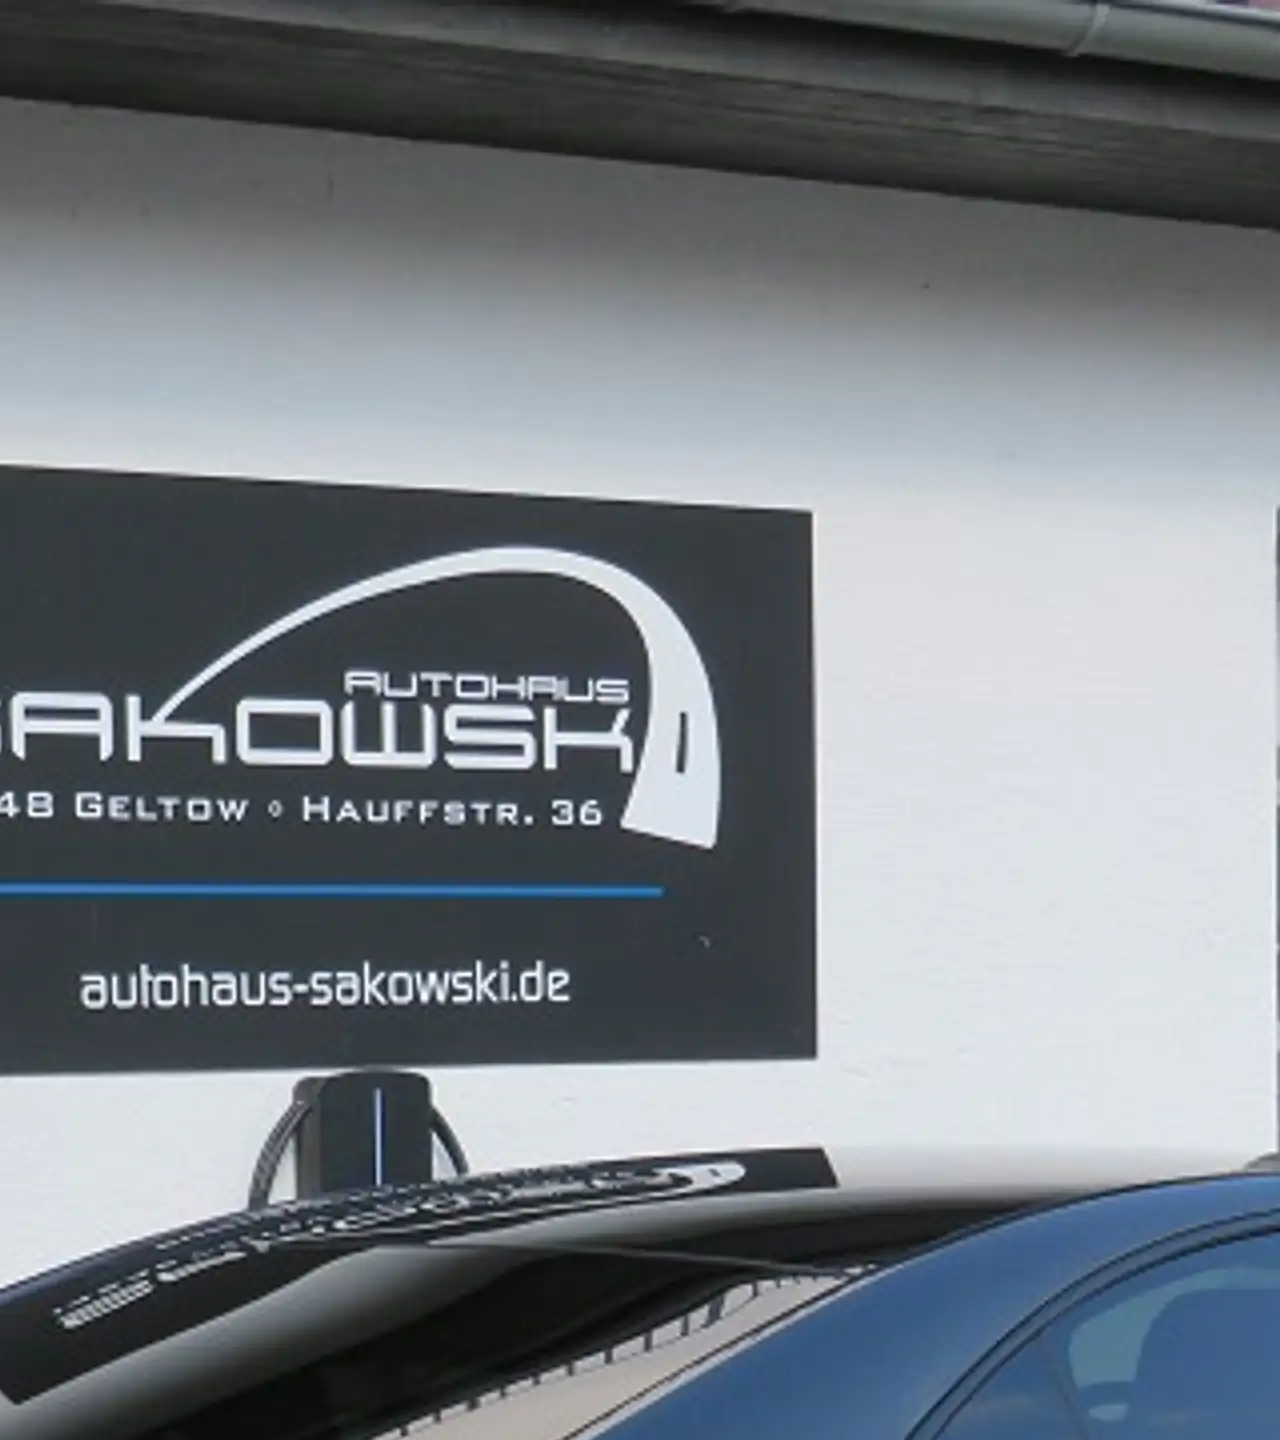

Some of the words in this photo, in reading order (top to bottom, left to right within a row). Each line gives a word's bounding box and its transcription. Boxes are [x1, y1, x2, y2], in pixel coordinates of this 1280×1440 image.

[342, 669, 631, 704] AUTOHAUS
[550, 799, 604, 828] 36
[79, 958, 572, 1011] autohaus-sakowski.de
